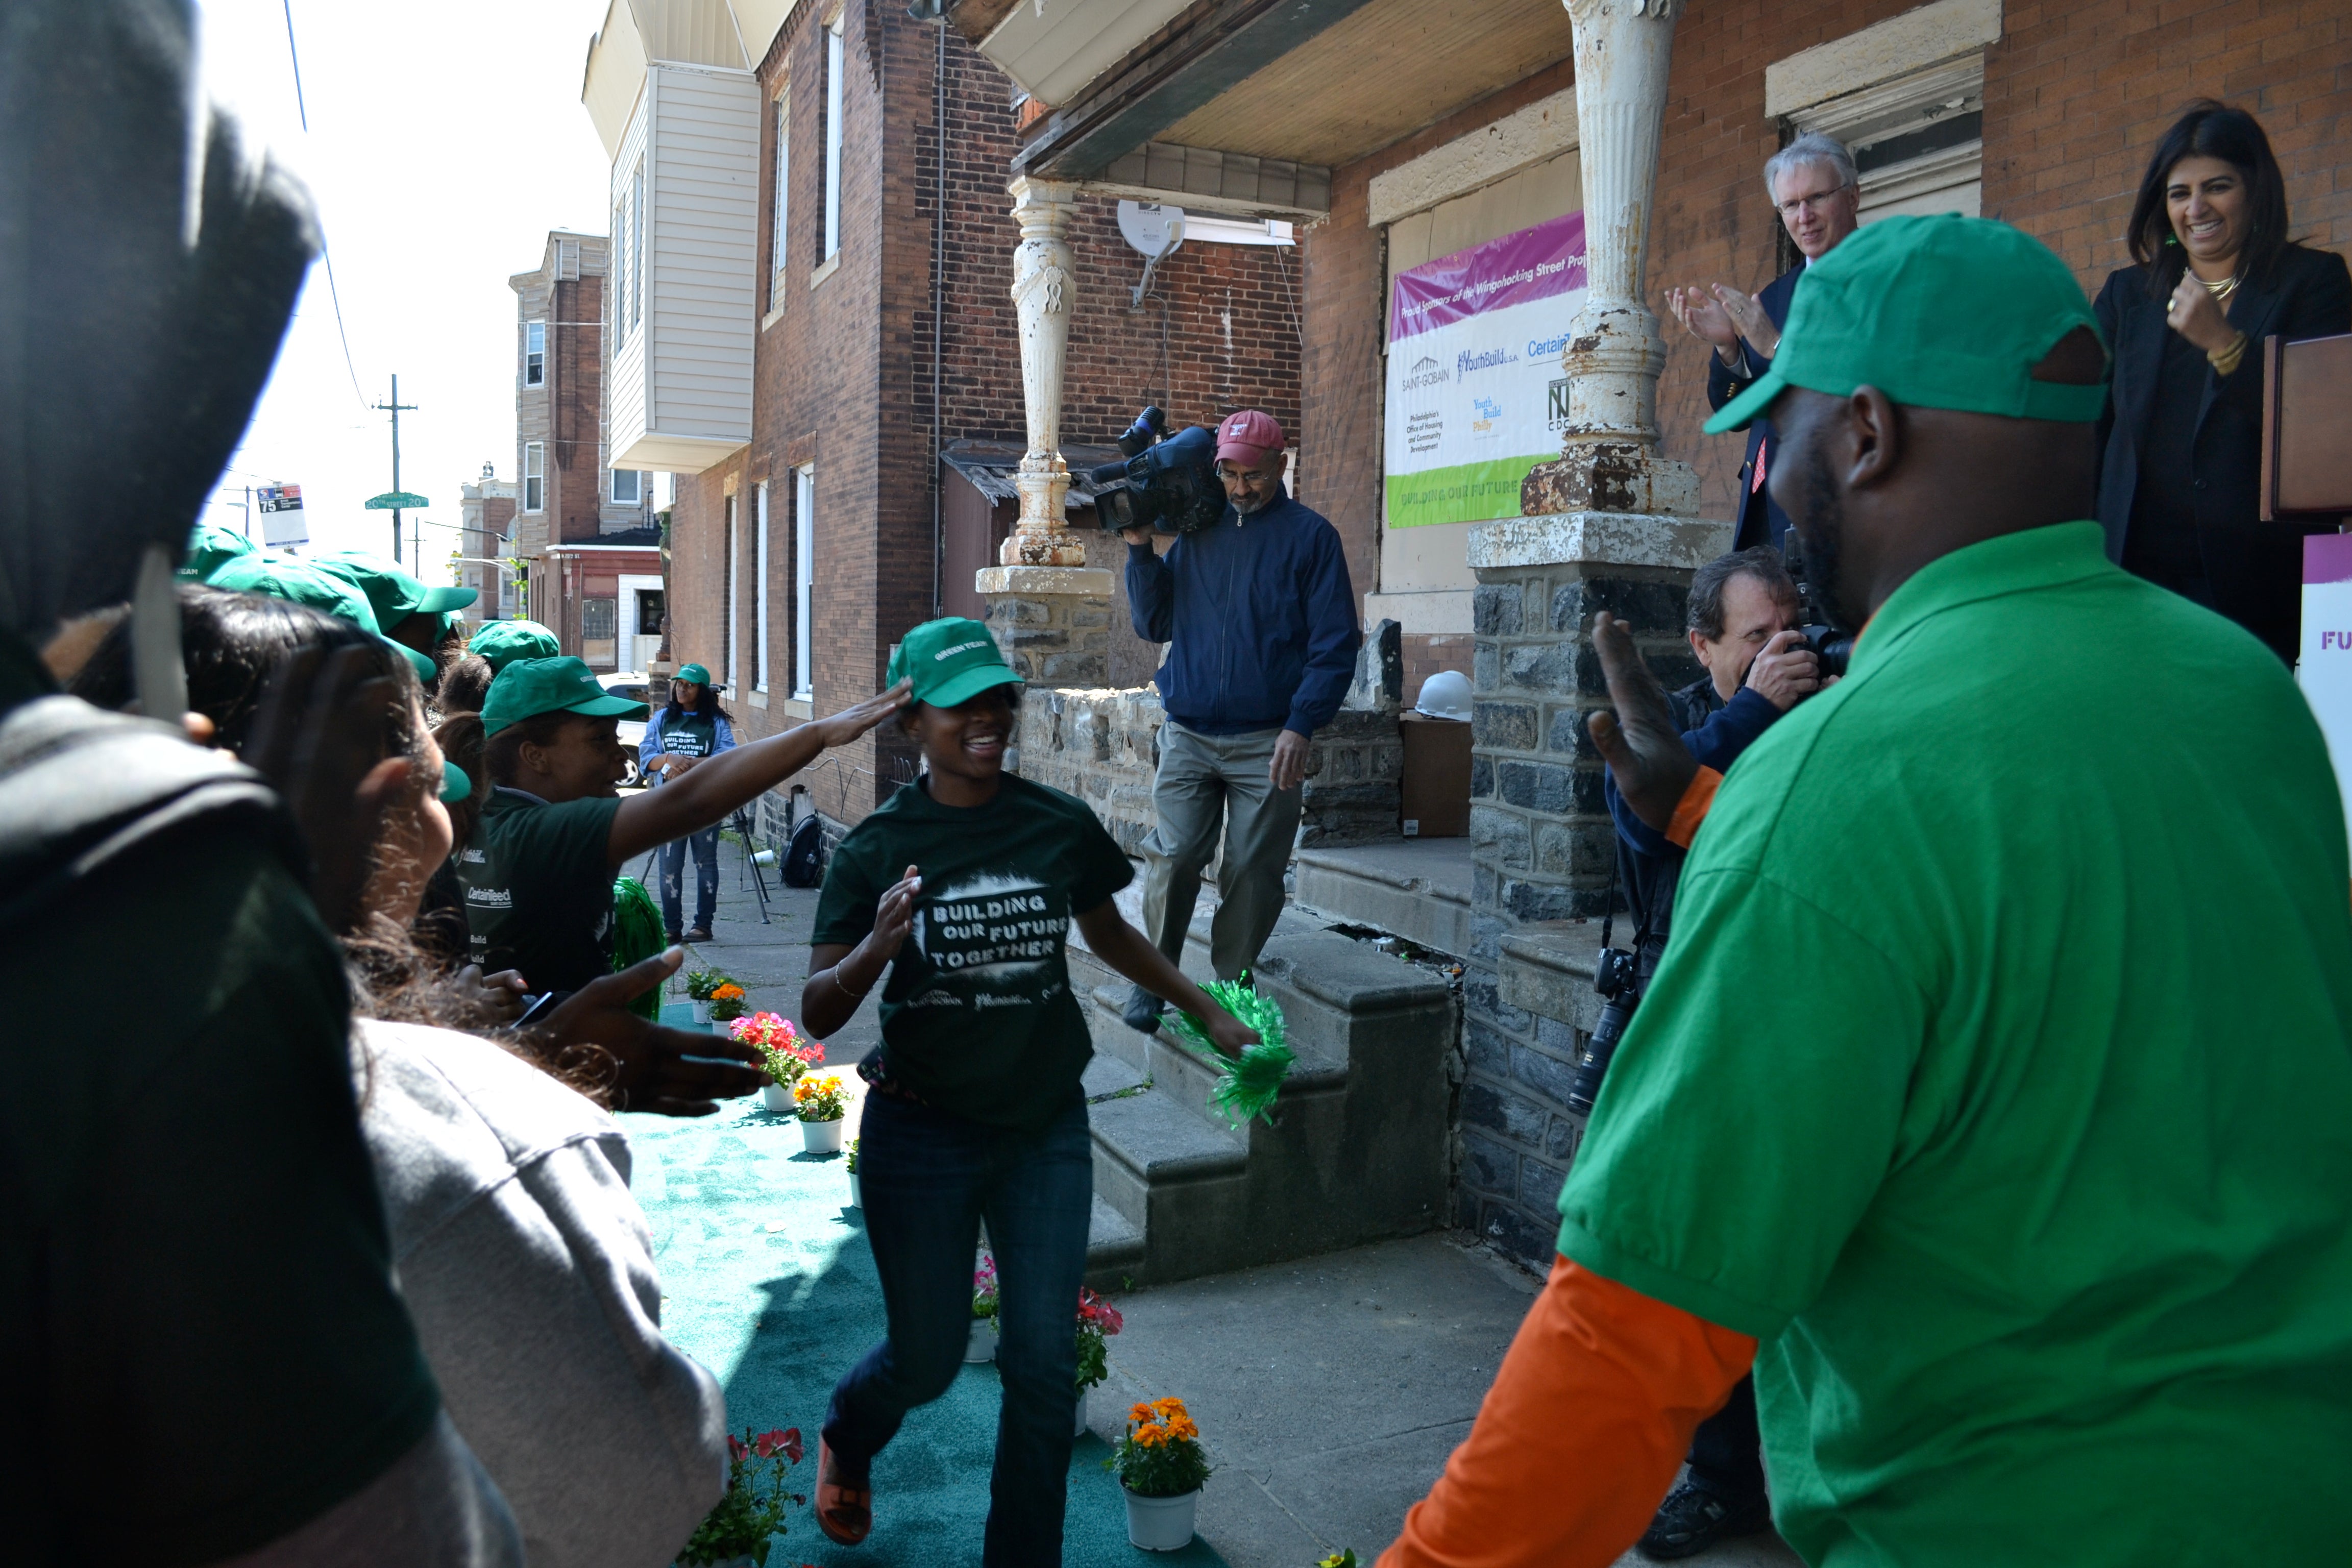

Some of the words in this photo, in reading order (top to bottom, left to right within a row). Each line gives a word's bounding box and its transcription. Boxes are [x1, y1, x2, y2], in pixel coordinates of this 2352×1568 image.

[1402, 302, 1421, 319] Proud
[1422, 296, 1451, 314] Sponsors
[1453, 292, 1462, 302] of
[1463, 288, 1475, 300] the
[1476, 268, 1533, 295] Wingohocking
[1536, 259, 1566, 277] Street
[1464, 348, 1504, 372] YouthBuild
[1403, 369, 1450, 391] SAINT-GOBAIN
[1474, 396, 1492, 410] Youth
[1410, 410, 1439, 422] Philadelphia's
[1484, 405, 1502, 419] Build
[1407, 425, 1418, 433] Office
[1419, 423, 1425, 431] of
[1425, 420, 1443, 429] Housing
[1473, 419, 1492, 432] Philly
[1408, 434, 1416, 444] and
[1417, 431, 1441, 440] Community
[1411, 443, 1438, 453] Development
[1401, 488, 1446, 506] BUILDING
[1448, 485, 1468, 500] OUR
[1472, 480, 1518, 497] FUTURE
[260, 500, 277, 512] 75
[366, 500, 386, 508] 20TH
[2321, 631, 2352, 650] FU
[468, 887, 511, 901] CertainTeed
[933, 895, 1046, 923] BUILDING
[943, 923, 986, 940] OUR
[990, 917, 1067, 943] FUTURE
[471, 935, 486, 944] Build
[471, 954, 484, 963] uild
[930, 940, 1055, 968] TOGETHER
